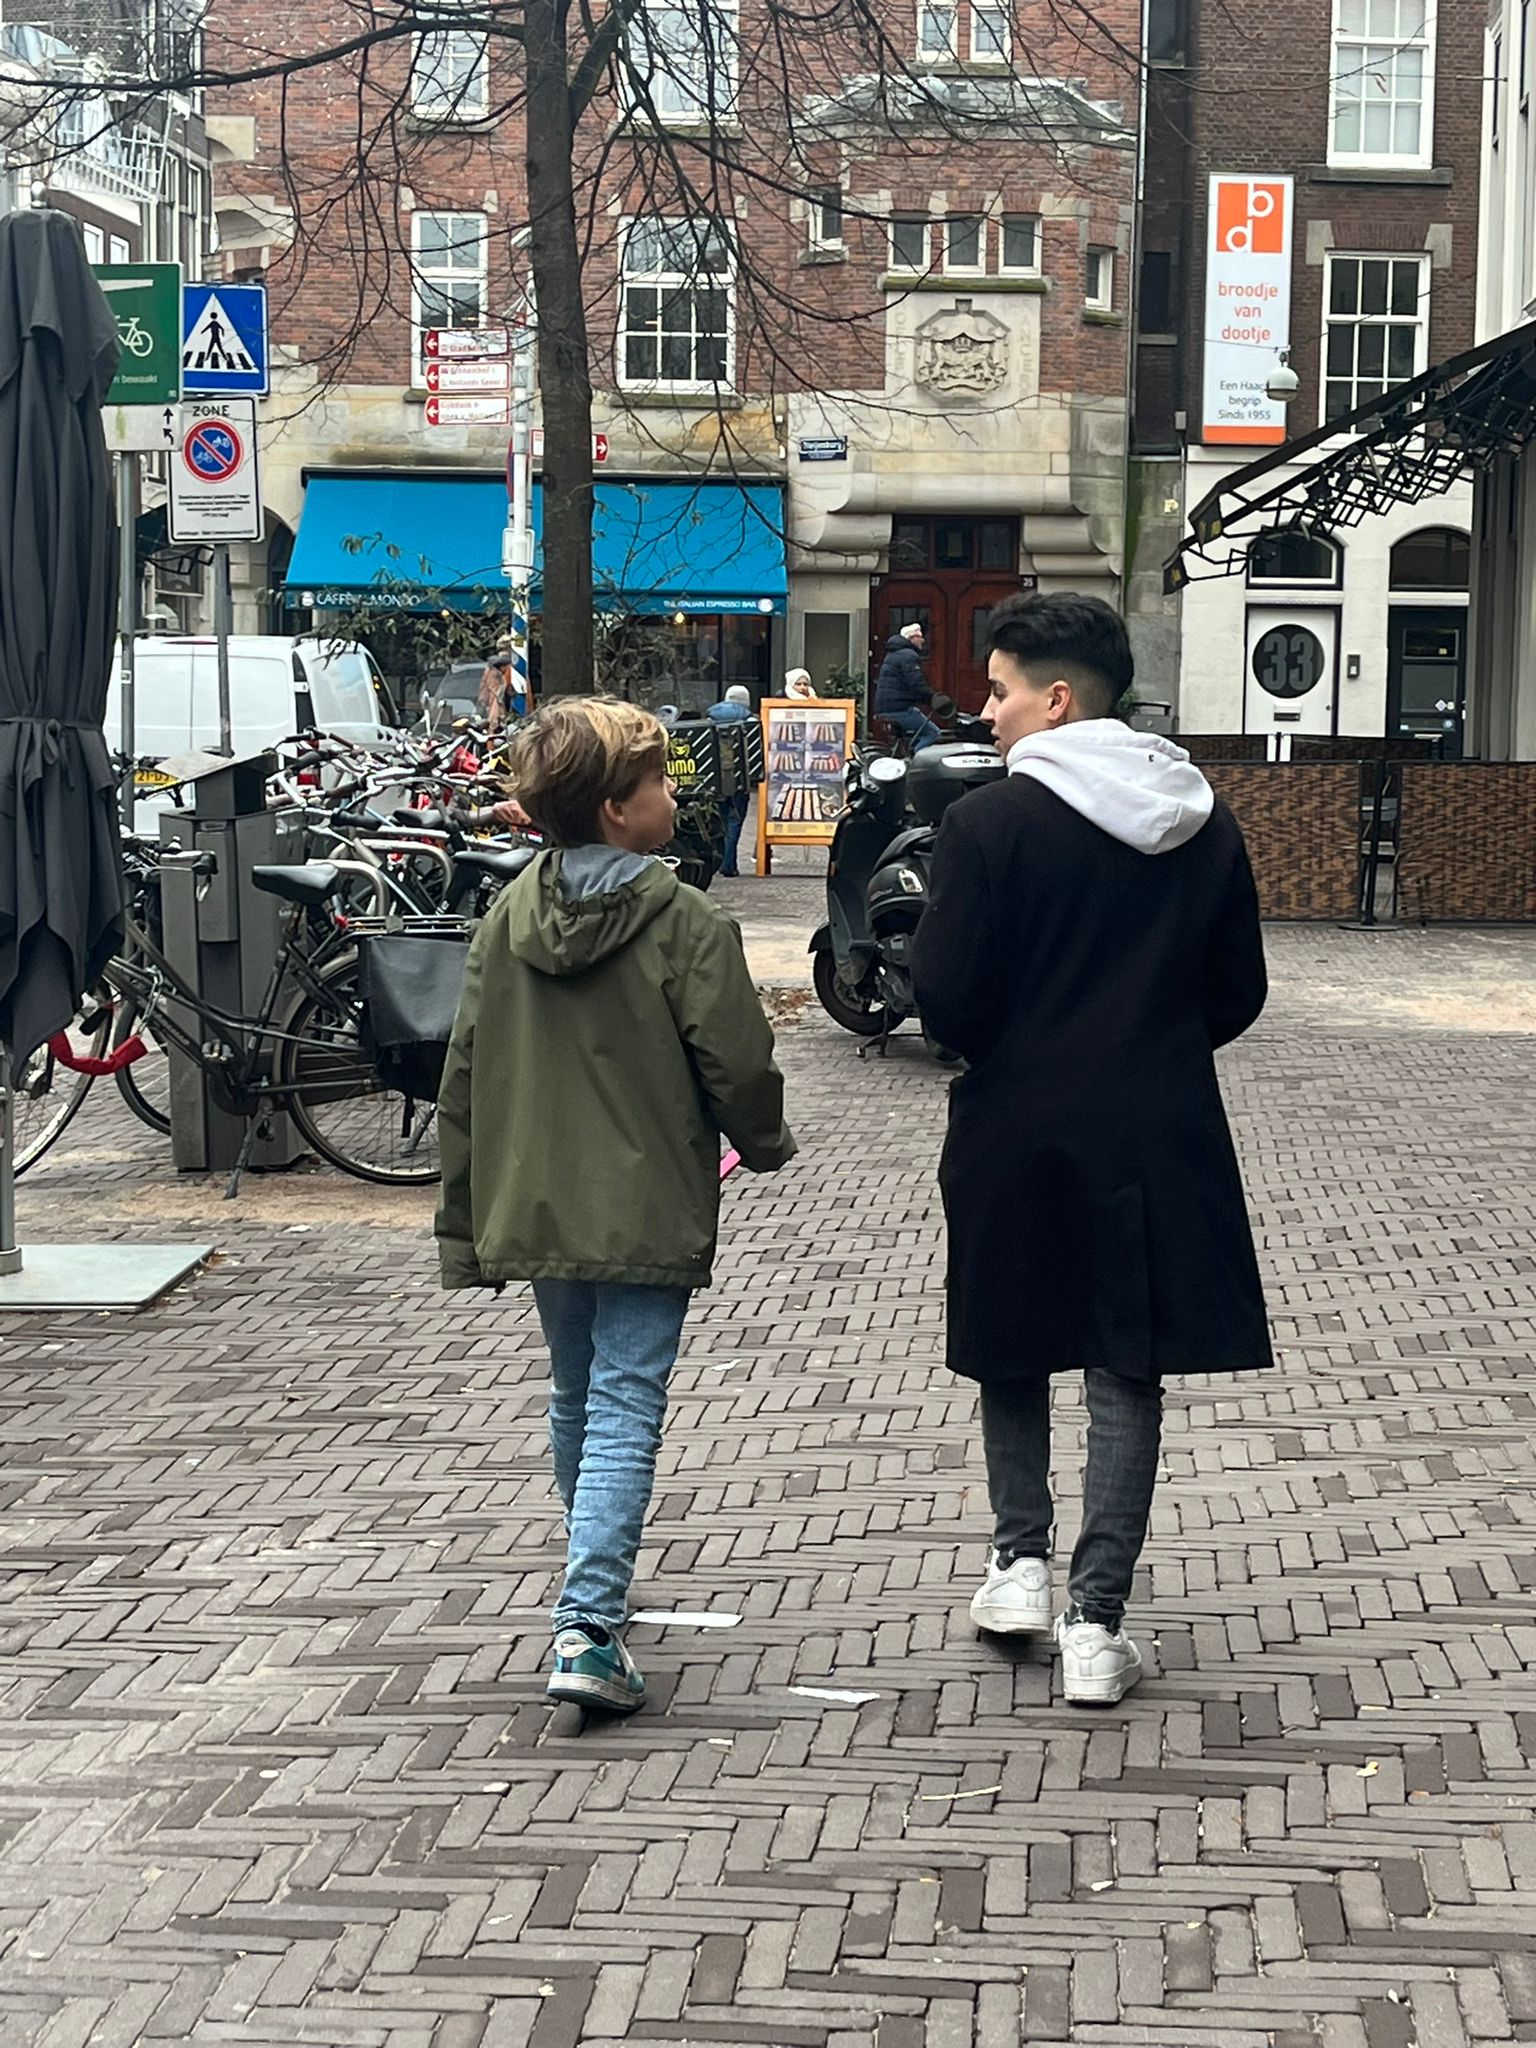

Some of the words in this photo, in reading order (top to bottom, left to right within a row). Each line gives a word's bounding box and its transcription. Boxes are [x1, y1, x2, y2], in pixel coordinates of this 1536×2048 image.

[1217, 281, 1279, 301] broodje
[1234, 306, 1262, 318] van
[1221, 324, 1271, 344] dootje
[1220, 380, 1239, 390] Een
[1240, 380, 1266, 393] Haag
[1228, 395, 1262, 407] begrip
[192, 404, 230, 417] ZONE
[1217, 409, 1245, 420] Sinds
[1248, 409, 1272, 420] 1955
[706, 600, 741, 608] ESPRESSO
[742, 600, 757, 608] BAR
[1263, 632, 1314, 690] 33
[666, 758, 696, 776] UMO
